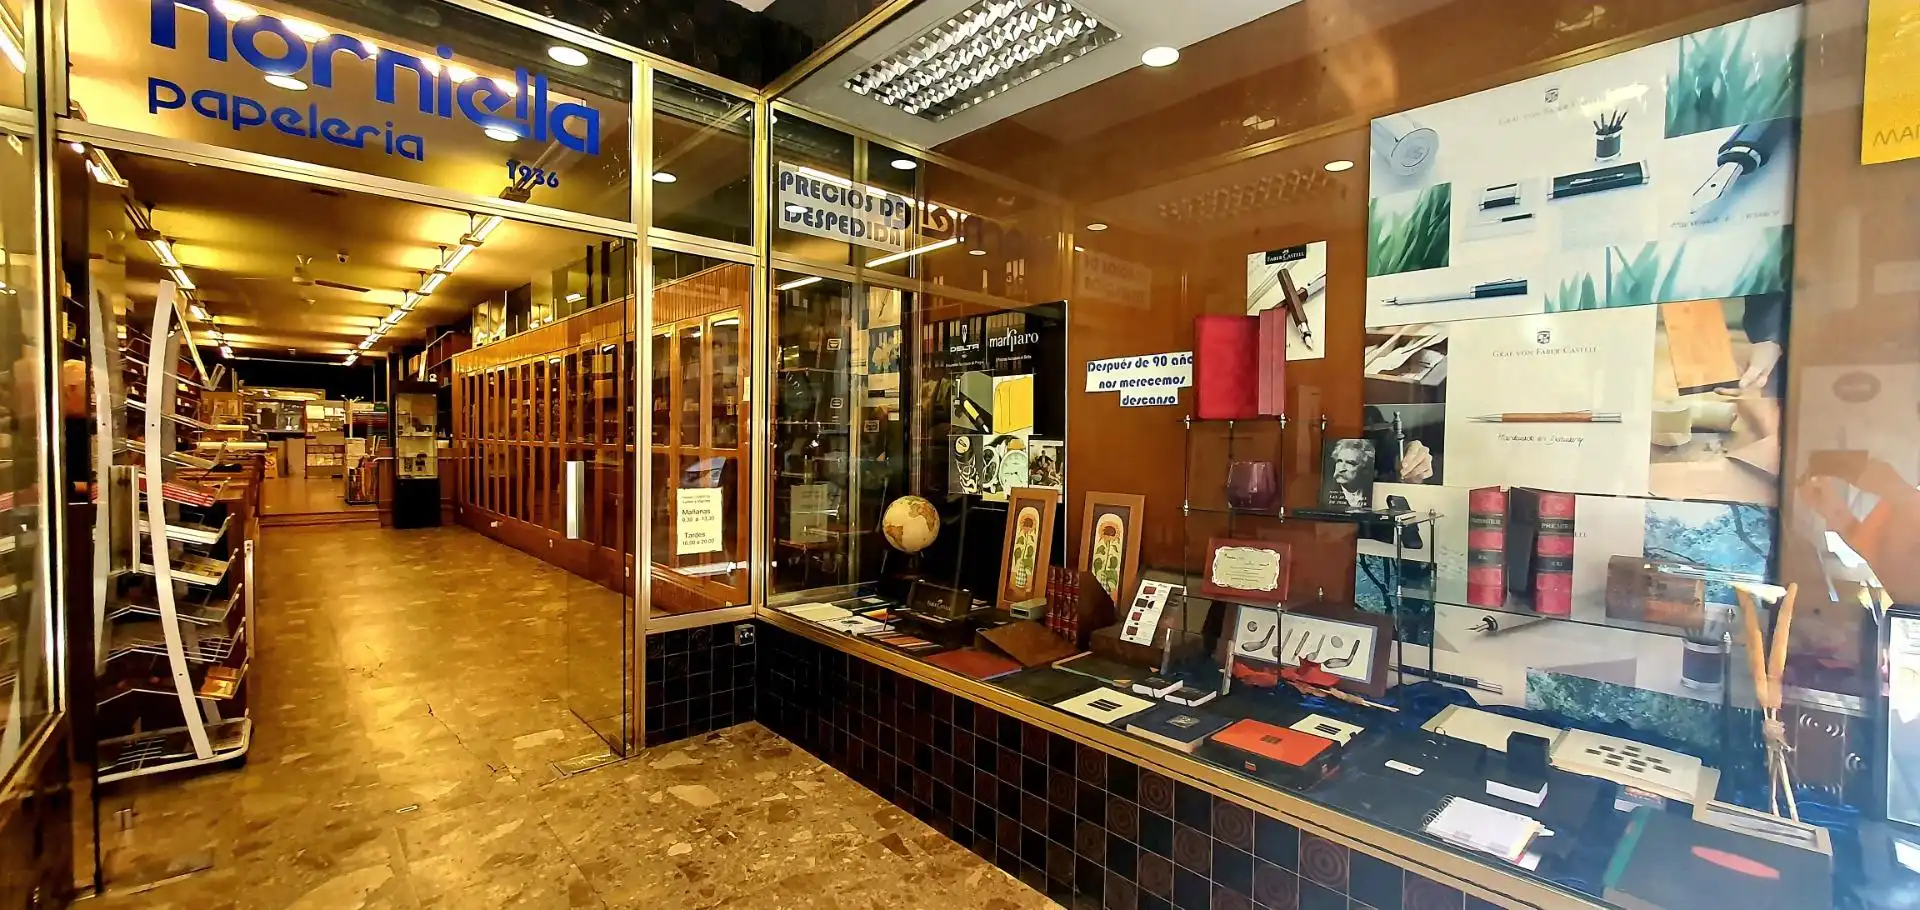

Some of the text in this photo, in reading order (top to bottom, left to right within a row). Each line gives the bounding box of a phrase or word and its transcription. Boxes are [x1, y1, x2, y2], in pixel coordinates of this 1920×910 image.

[147, 76, 424, 162] papeleria
[506, 159, 560, 189] 1936
[780, 171, 905, 221] PRECIOS DE
[784, 201, 902, 247] DESPEDIDA
[949, 343, 980, 352] DELTA
[1087, 358, 1133, 373] Después
[1134, 357, 1150, 368] de
[1152, 355, 1168, 367] 90
[1098, 376, 1186, 389] nos merecemos
[1121, 395, 1176, 406] descanso
